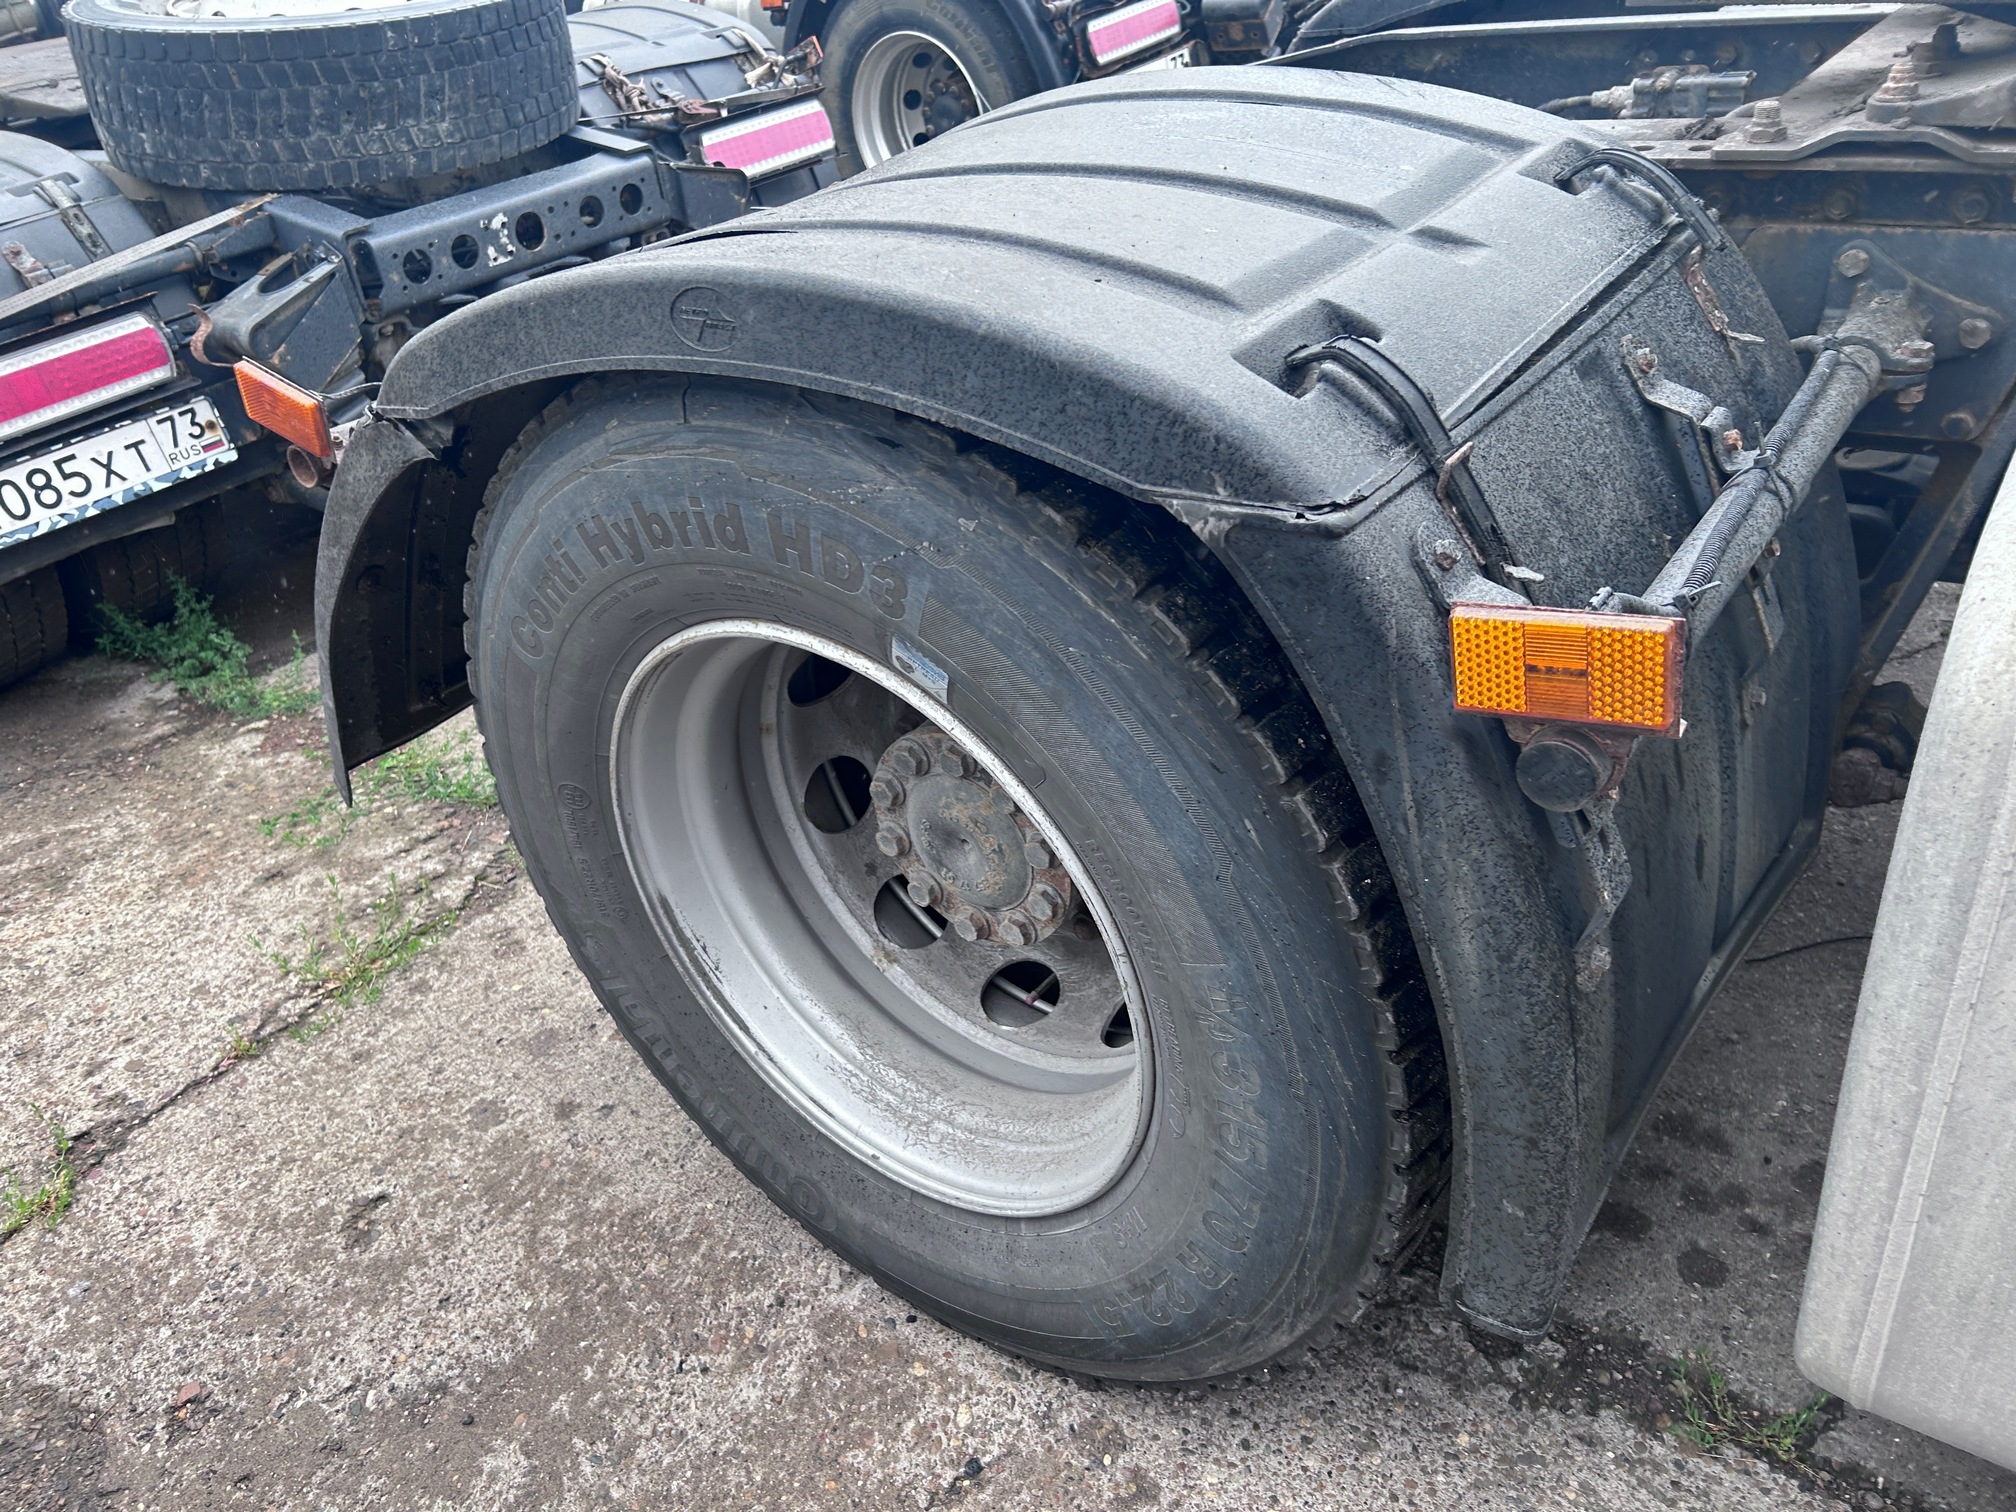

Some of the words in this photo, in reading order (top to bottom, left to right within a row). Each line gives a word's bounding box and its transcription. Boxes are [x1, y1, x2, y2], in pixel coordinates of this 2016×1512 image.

[156, 406, 206, 449] 73
[168, 446, 202, 466] RUS
[510, 537, 588, 659] Conti
[575, 496, 752, 569] Hybrid
